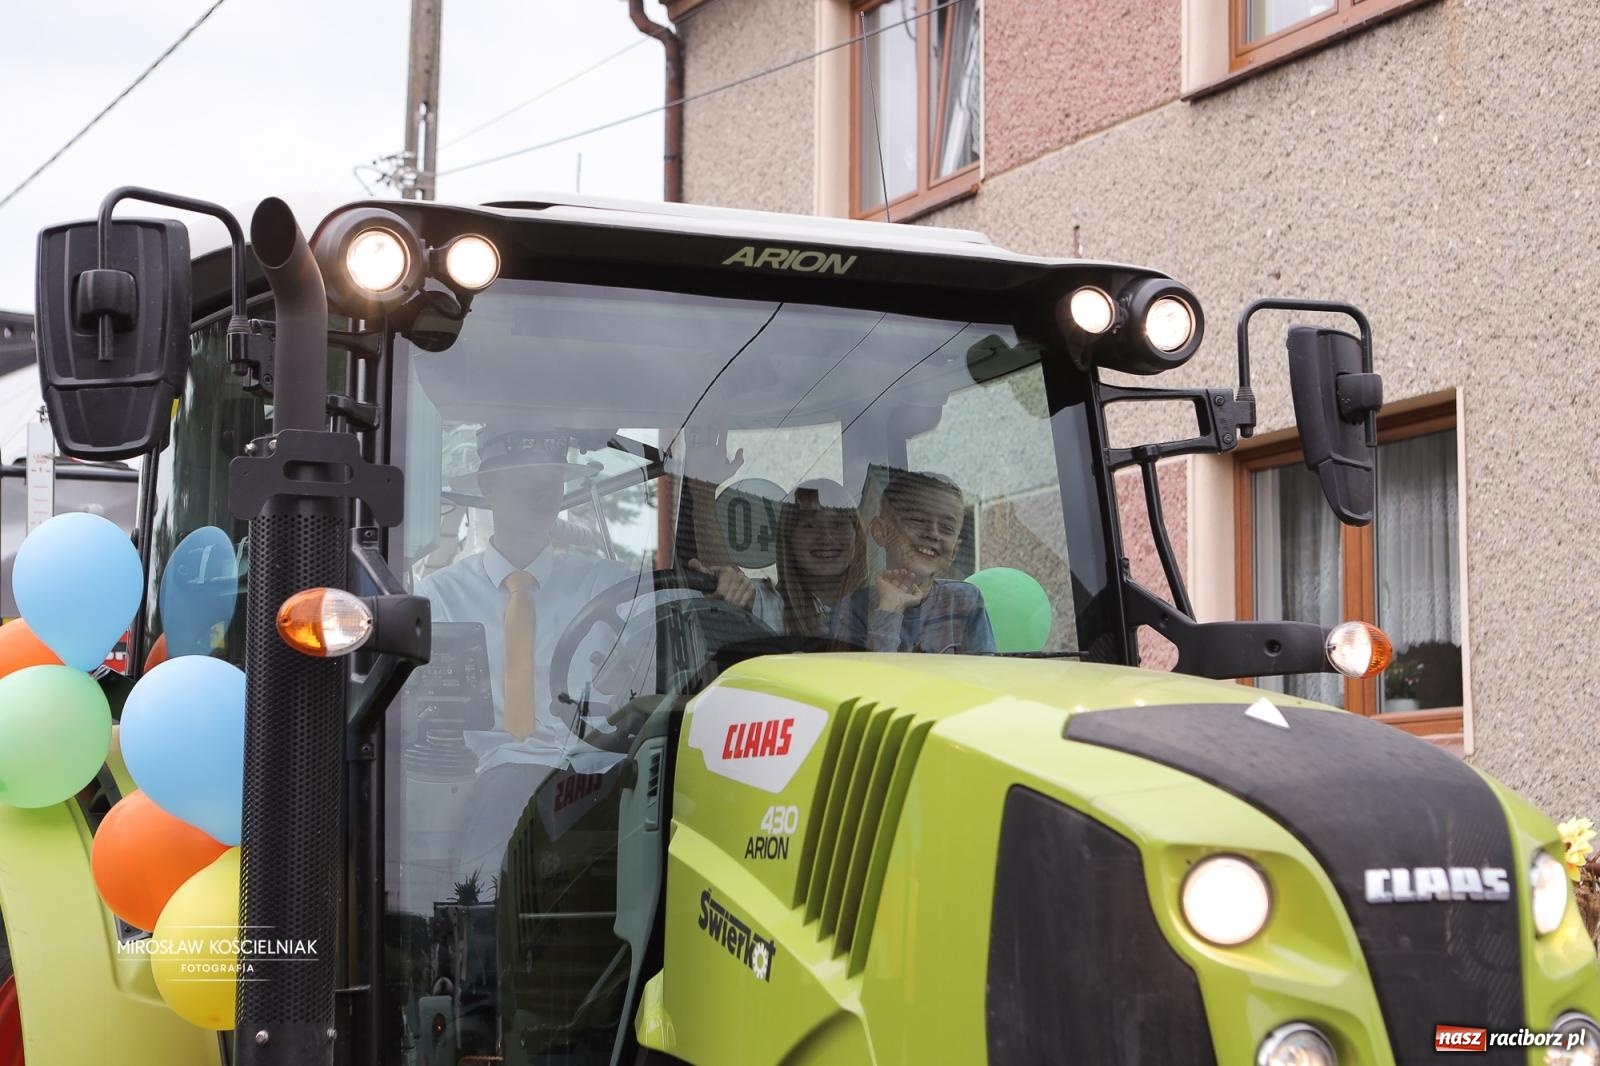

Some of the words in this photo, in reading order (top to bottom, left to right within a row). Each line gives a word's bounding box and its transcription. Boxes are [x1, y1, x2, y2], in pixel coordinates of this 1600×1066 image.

[721, 246, 858, 275] ARION
[721, 717, 796, 761] CLAAS
[760, 805, 800, 835] 430
[744, 836, 790, 860] ARION
[1364, 866, 1511, 904] CLAAS
